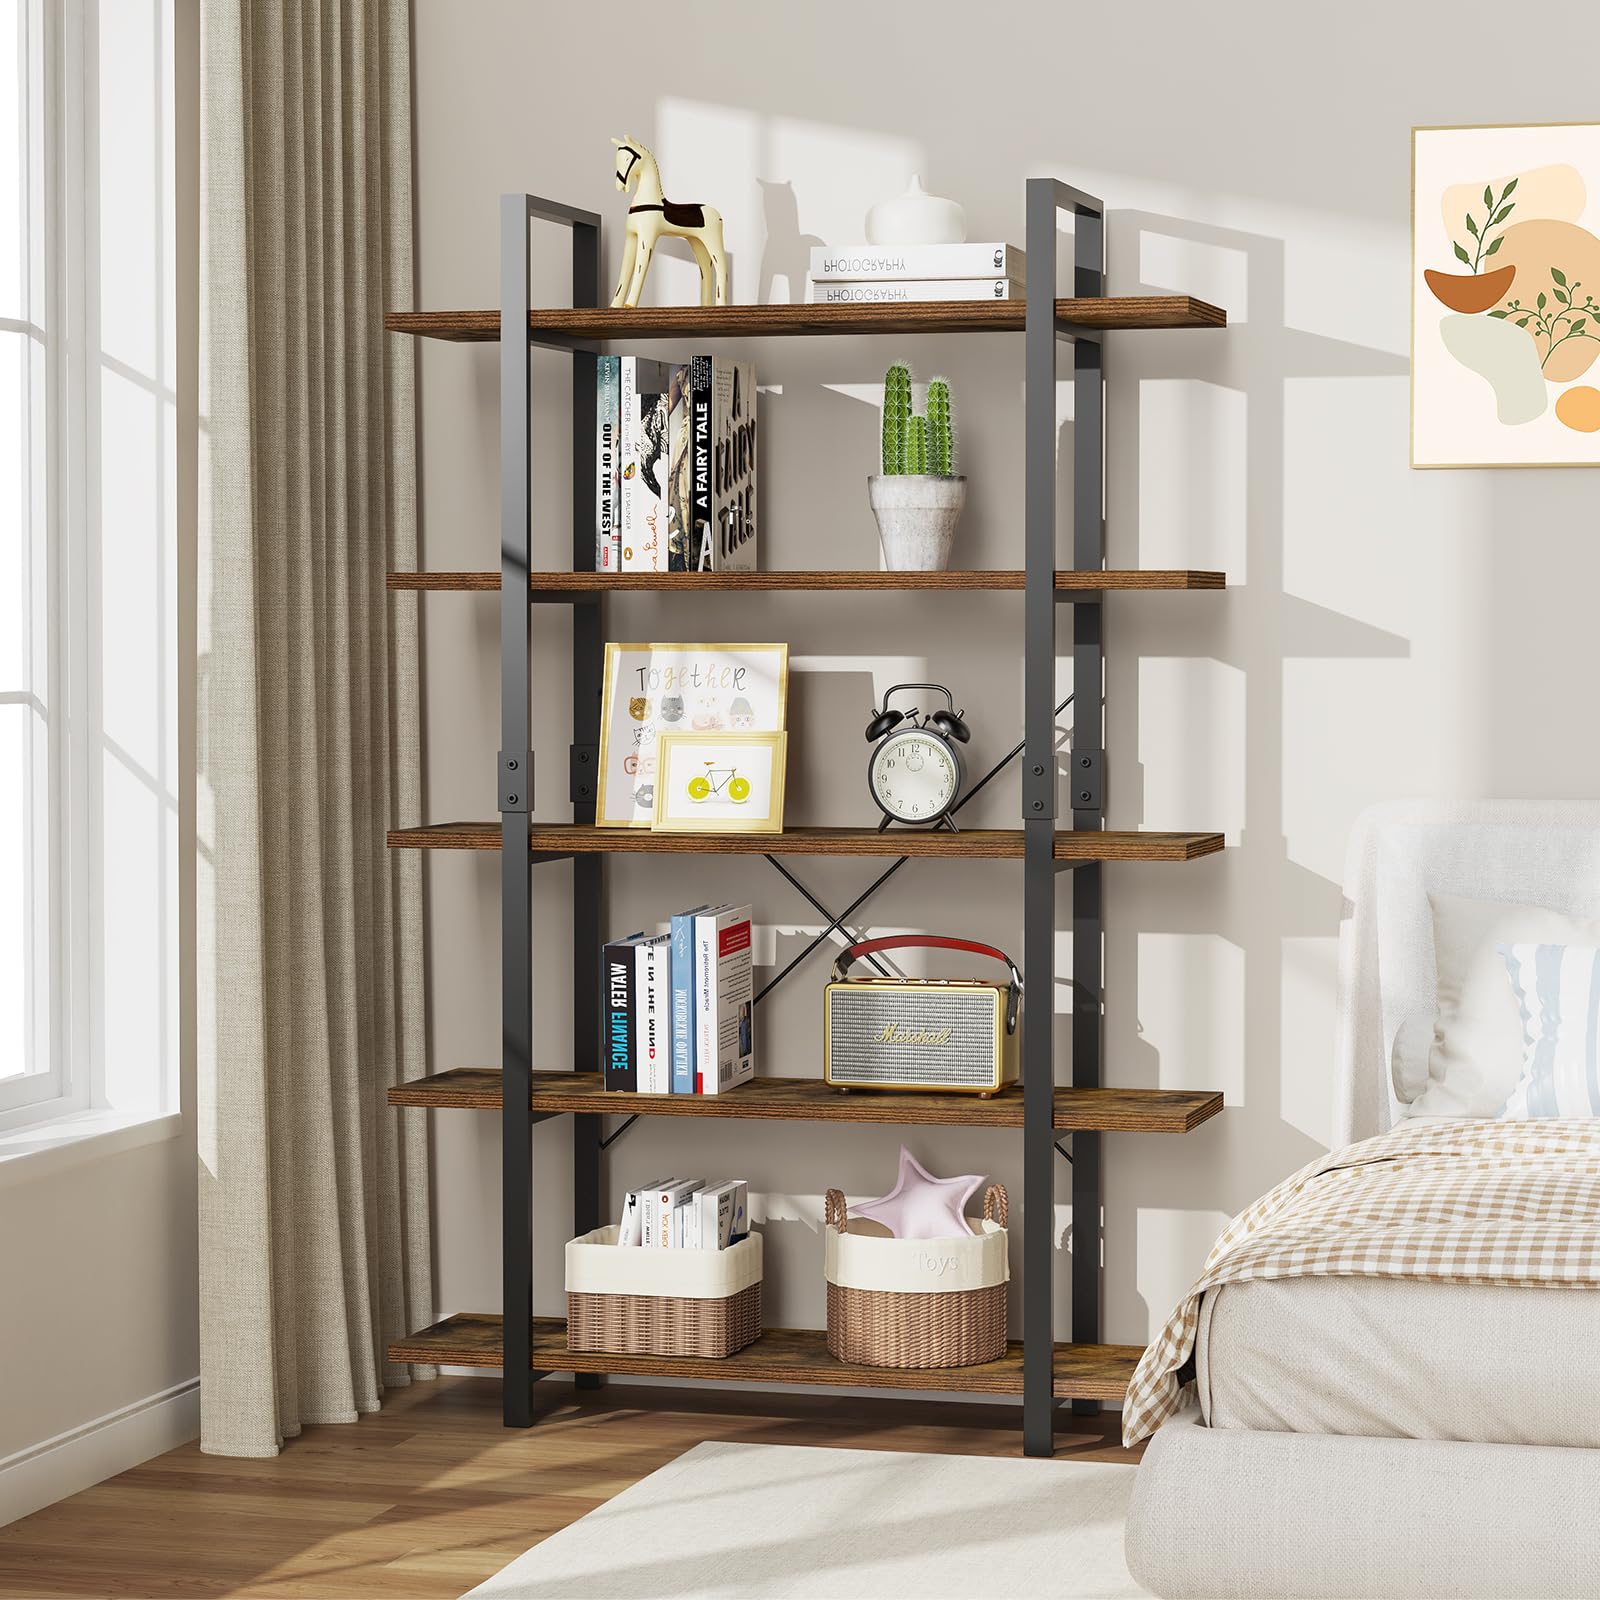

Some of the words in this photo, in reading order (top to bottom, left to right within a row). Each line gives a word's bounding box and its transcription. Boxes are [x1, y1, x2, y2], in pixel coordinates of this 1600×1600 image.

[624, 368, 632, 384] THE
[624, 386, 632, 423] CATCHER
[696, 402, 708, 441] TALE
[602, 423, 612, 449] OUT
[602, 453, 612, 469] OF
[624, 443, 632, 457] RYE
[696, 444, 708, 491] FAIRY
[602, 472, 612, 495] THE
[697, 495, 708, 508] A
[602, 498, 612, 537] WEST
[897, 747, 906, 758] 11
[911, 743, 921, 754] 12
[887, 759, 896, 769] 10
[873, 1022, 953, 1045] Marshall
[913, 1252, 959, 1277] Toys
